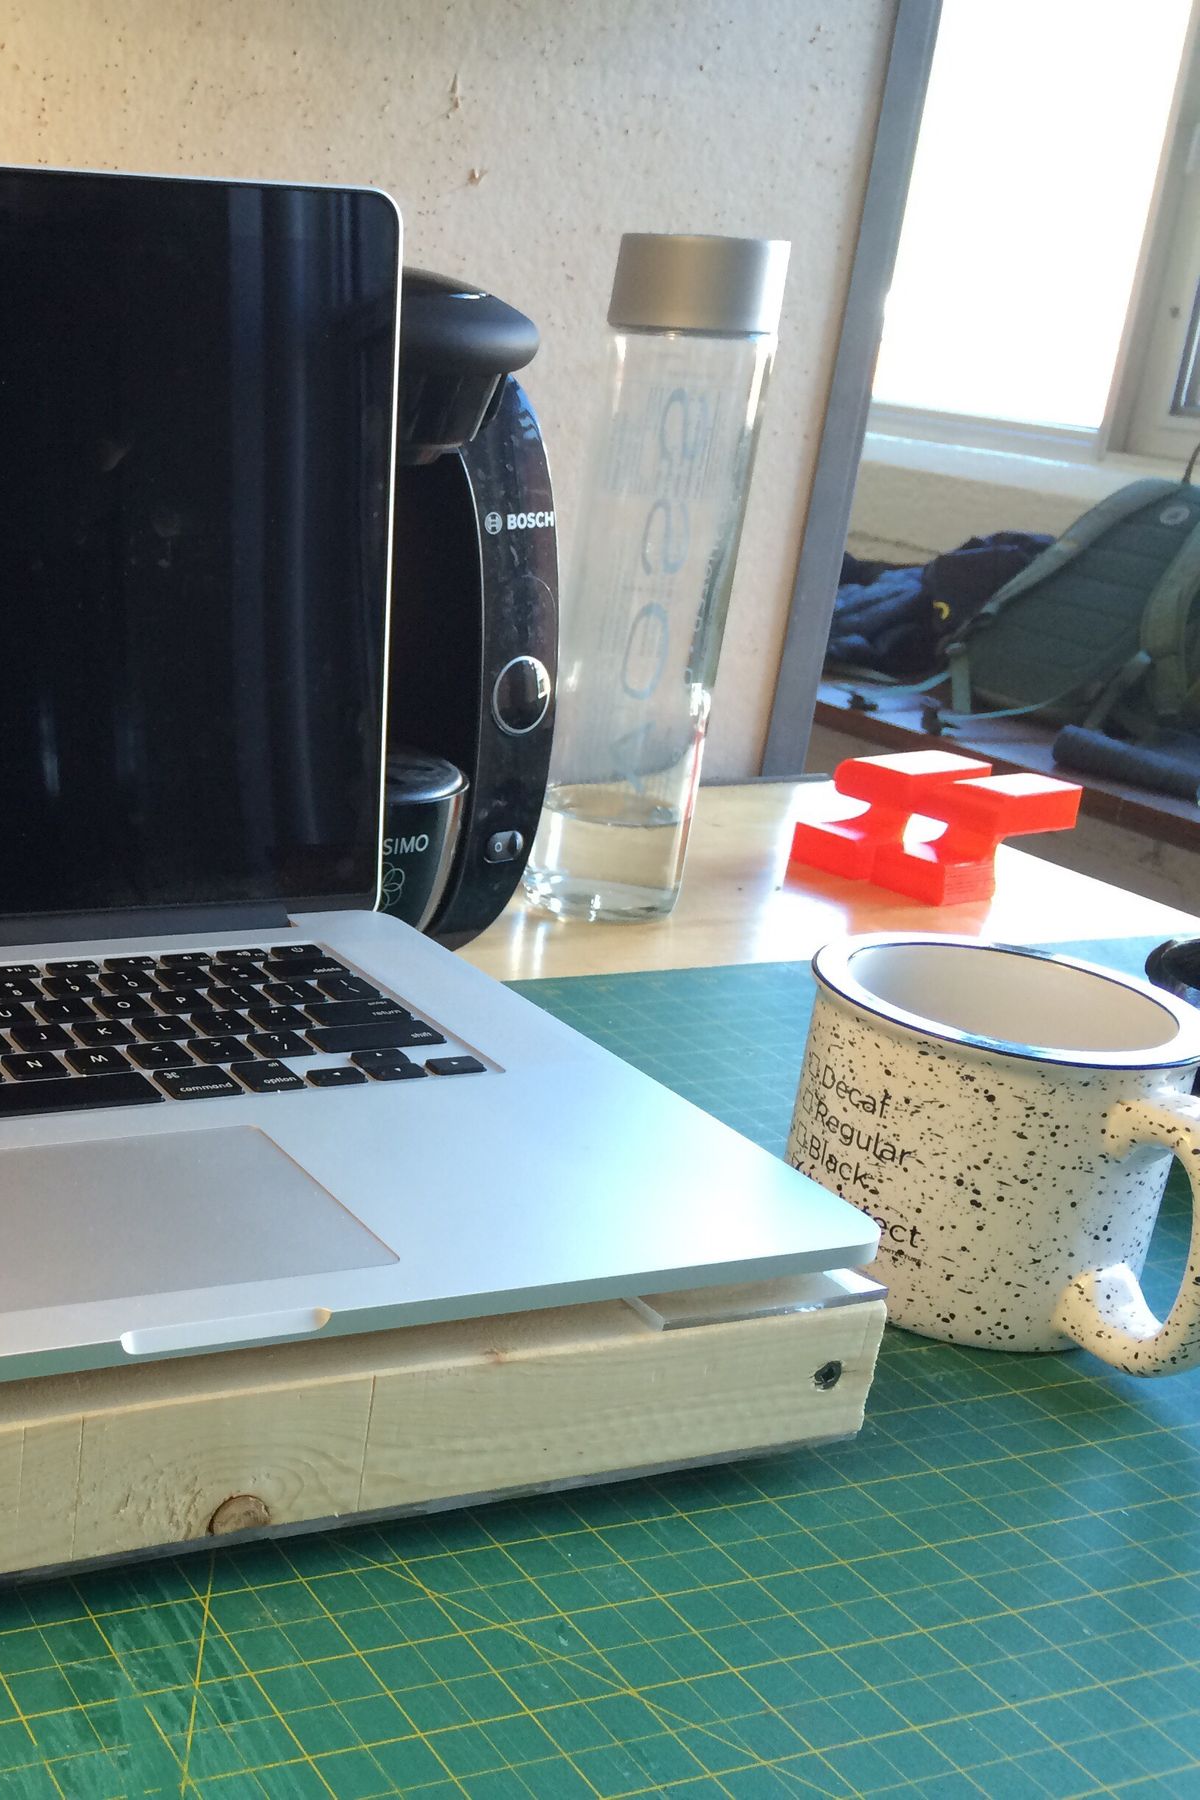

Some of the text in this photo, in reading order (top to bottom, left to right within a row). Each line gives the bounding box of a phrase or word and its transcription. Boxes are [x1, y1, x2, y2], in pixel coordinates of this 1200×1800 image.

[506, 511, 554, 530] BOSCH
[383, 834, 429, 856] SIMO
[116, 1001, 131, 1009] O
[175, 996, 187, 1004] P
[96, 1027, 112, 1035] K
[158, 1023, 172, 1031] L
[40, 1032, 48, 1040] J
[89, 1054, 109, 1063] M
[26, 1059, 43, 1069] N
[263, 1074, 299, 1085] option
[179, 1081, 233, 1093] command
[821, 1064, 892, 1118] Decaf
[814, 1100, 912, 1165] Regular
[808, 1135, 868, 1189] Black
